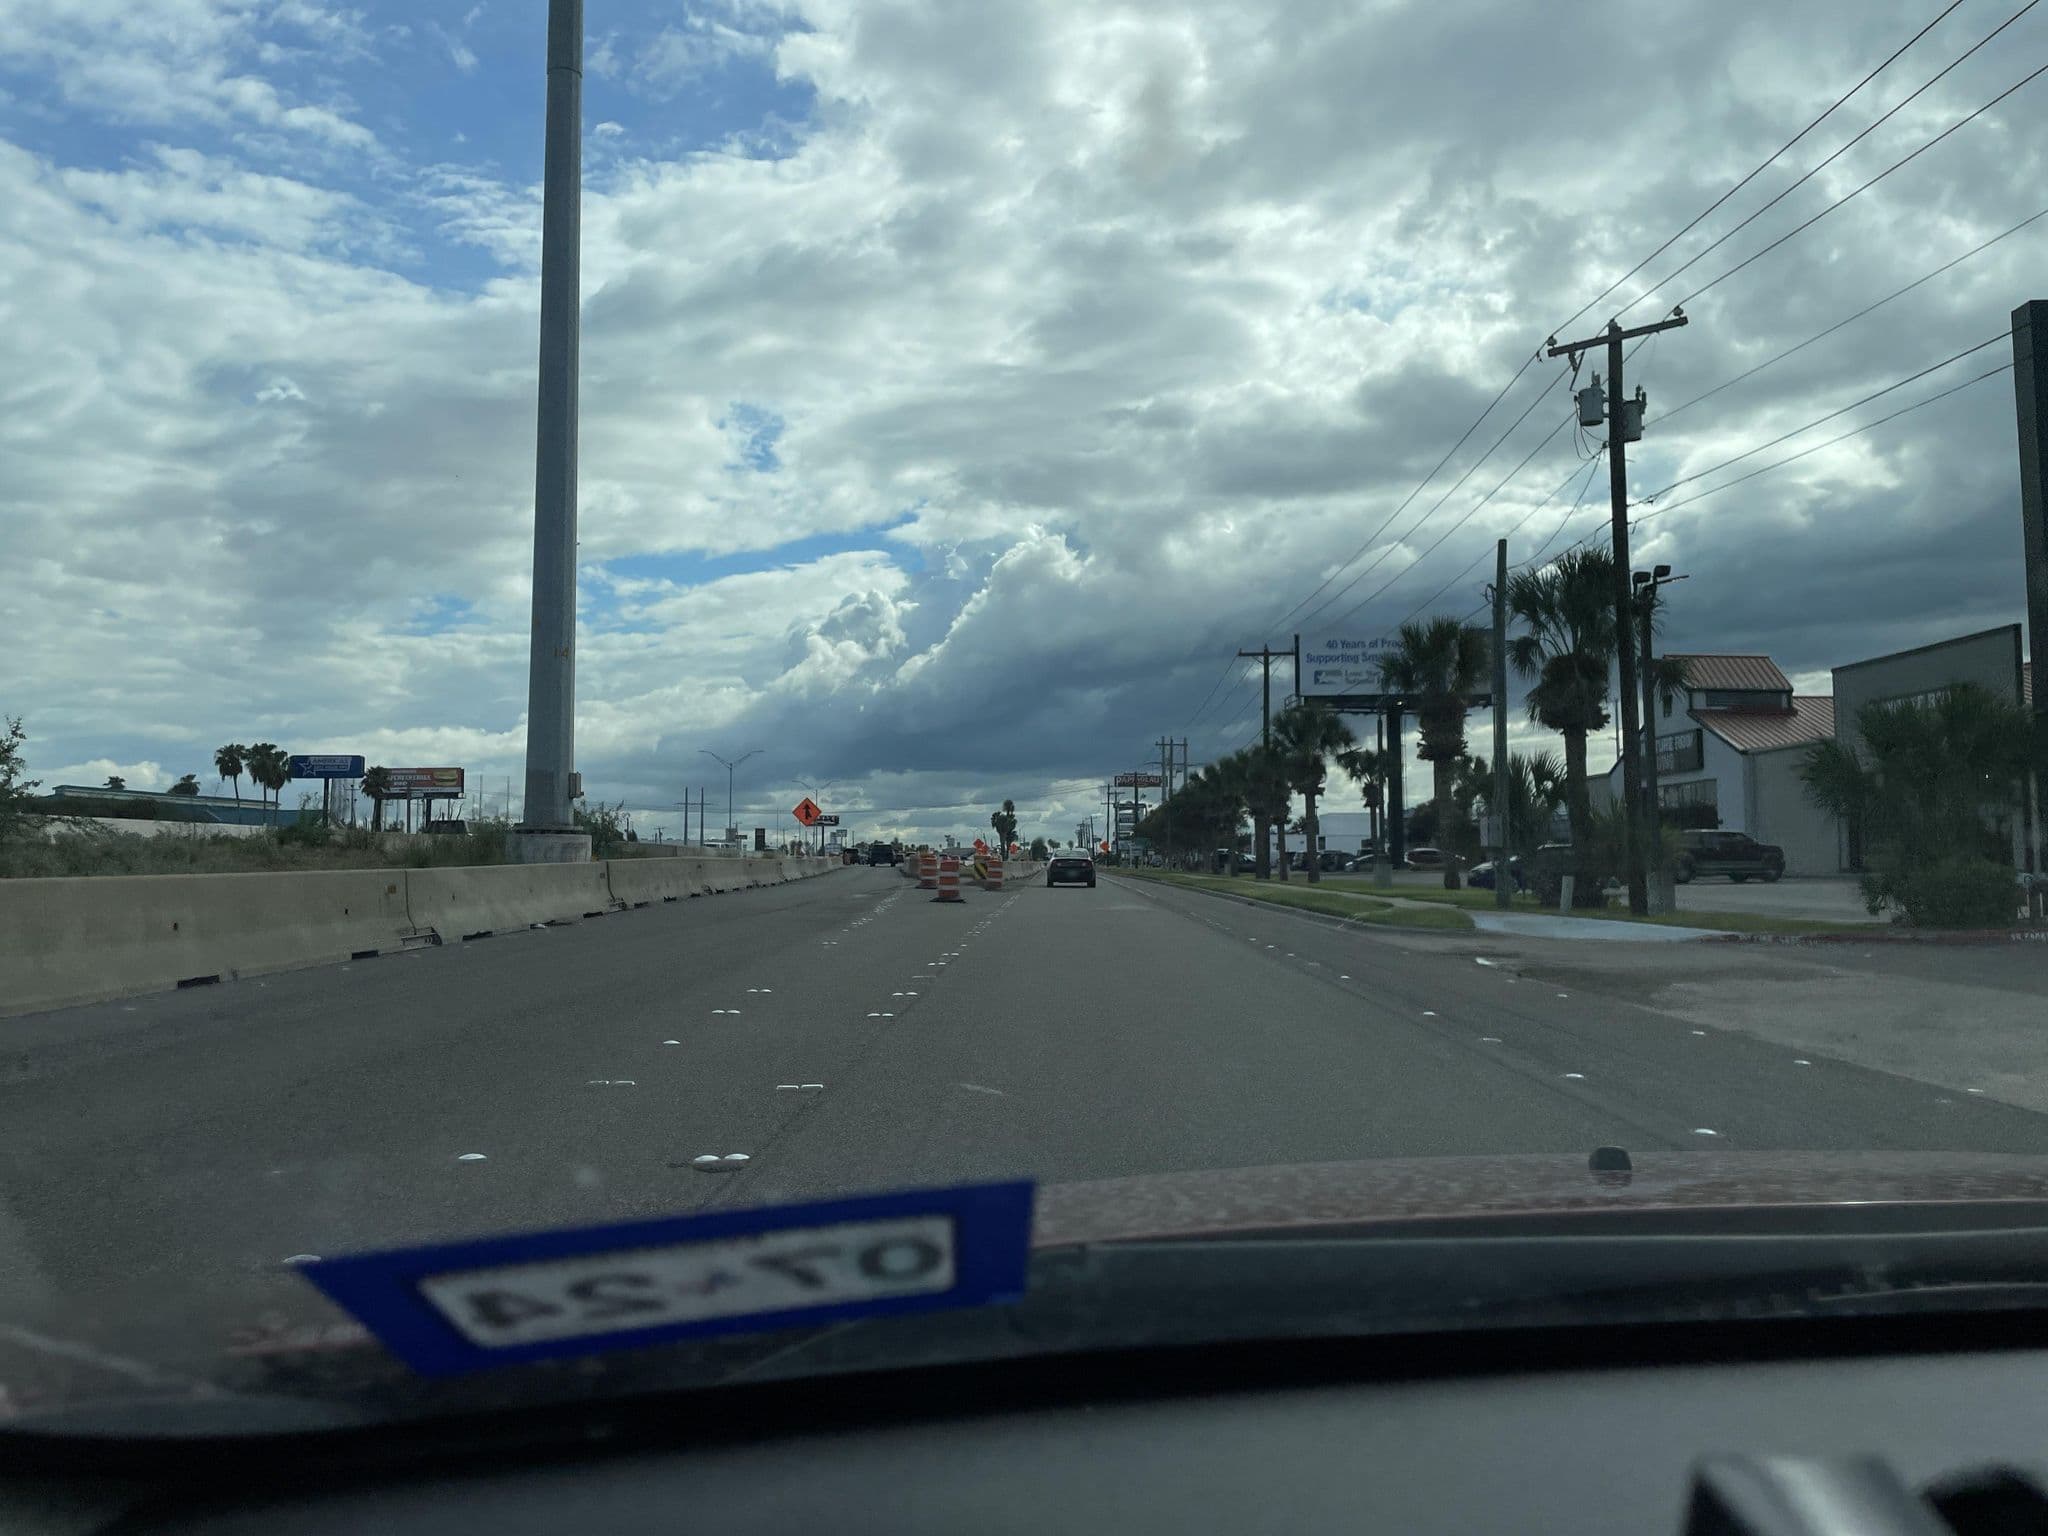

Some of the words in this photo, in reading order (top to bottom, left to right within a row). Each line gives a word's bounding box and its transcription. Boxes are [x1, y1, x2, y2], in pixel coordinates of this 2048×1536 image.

[1326, 639, 1338, 649] 40
[1340, 639, 1366, 649] Years
[1368, 638, 1378, 649] of
[1306, 652, 1359, 665] Supporting
